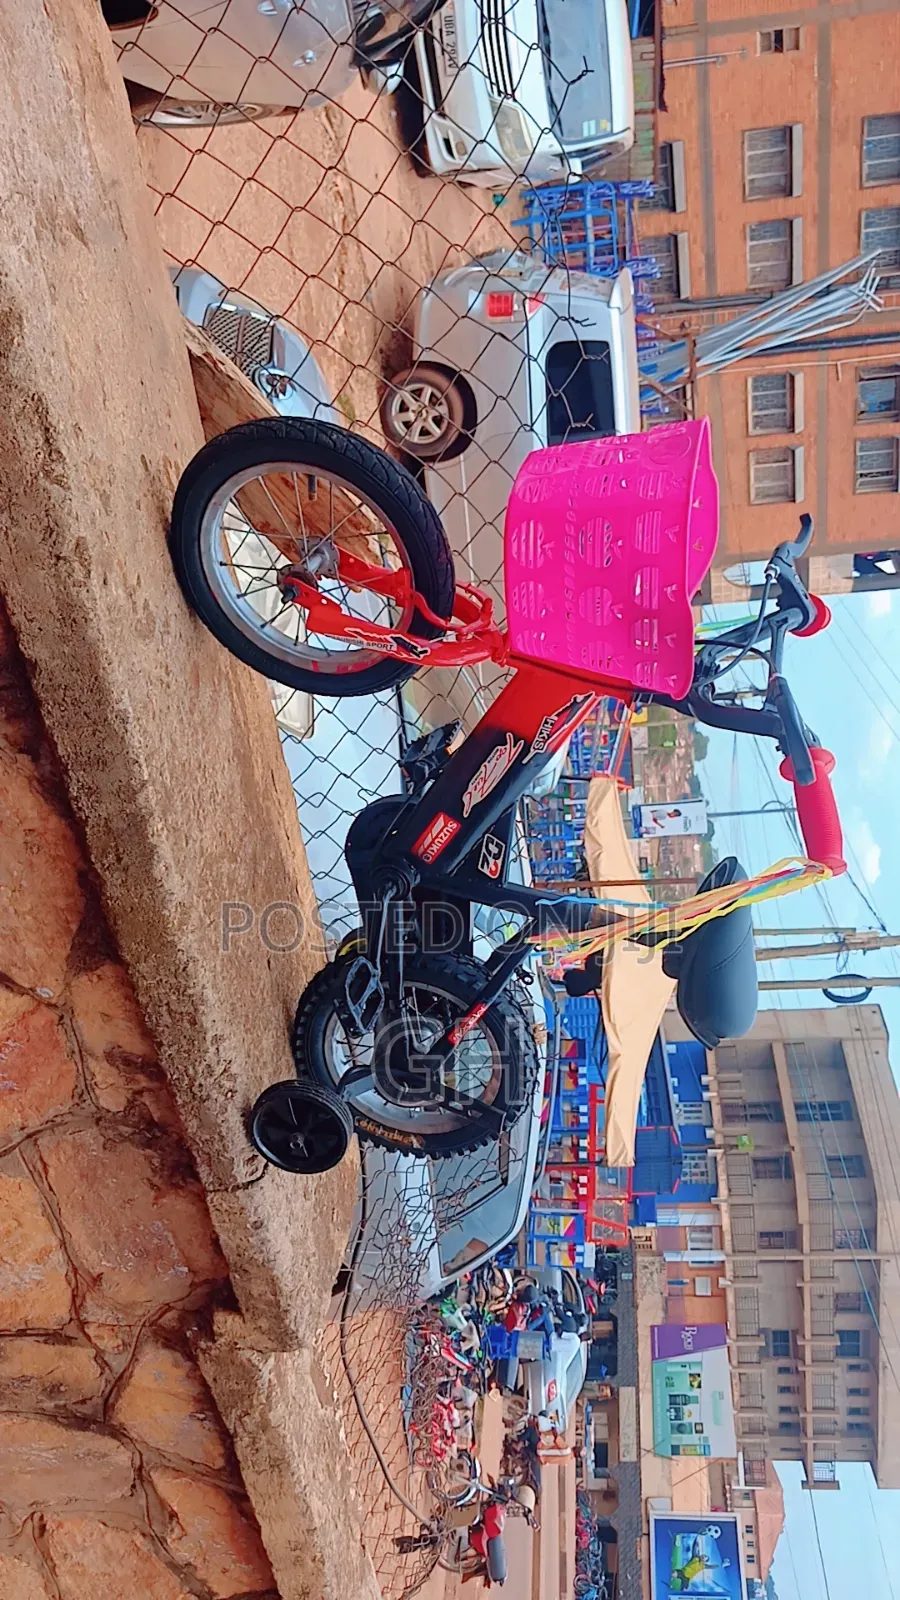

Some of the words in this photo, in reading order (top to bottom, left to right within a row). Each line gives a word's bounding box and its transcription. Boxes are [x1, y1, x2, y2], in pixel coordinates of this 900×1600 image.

[444, 15, 455, 36] UBA
[532, 718, 555, 750] HKS
[426, 820, 458, 856] SUZUKI
